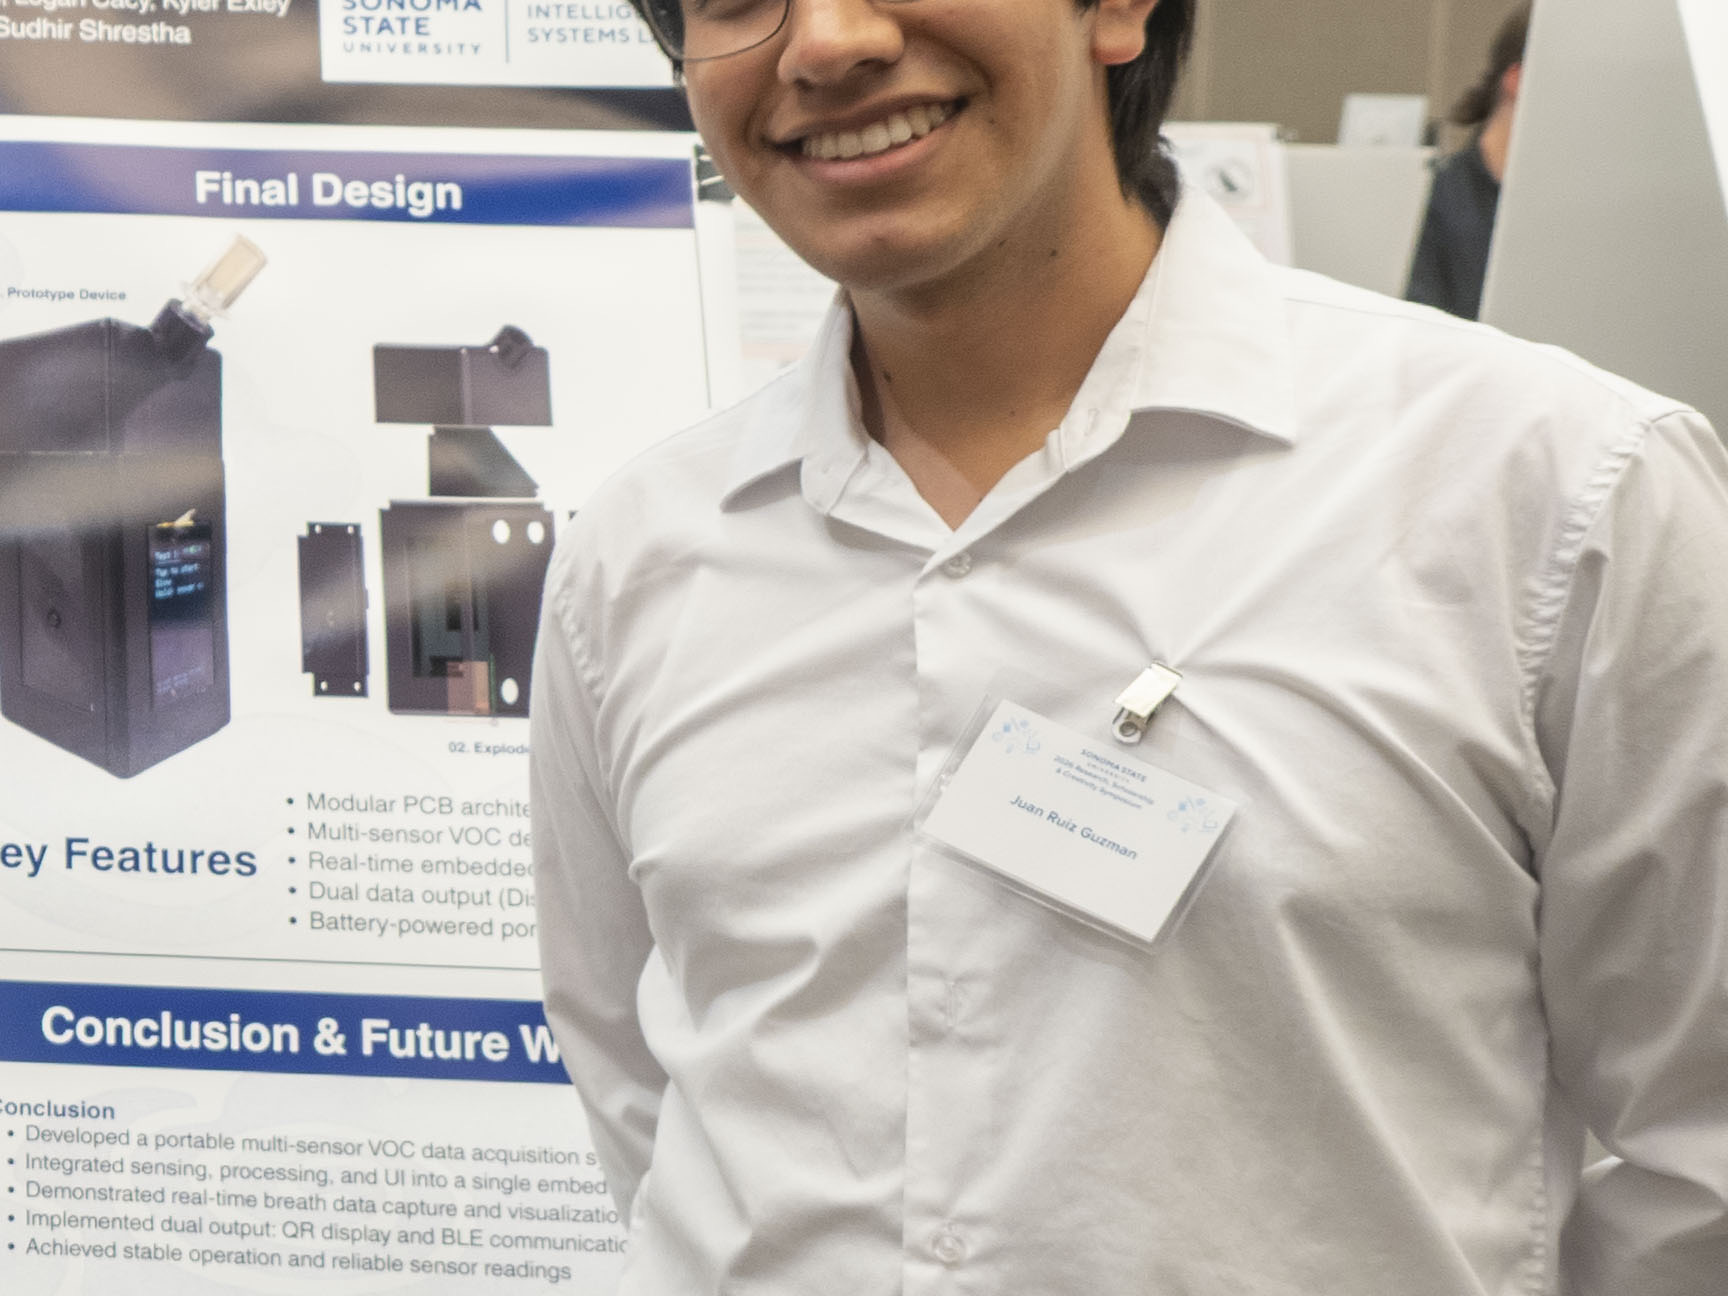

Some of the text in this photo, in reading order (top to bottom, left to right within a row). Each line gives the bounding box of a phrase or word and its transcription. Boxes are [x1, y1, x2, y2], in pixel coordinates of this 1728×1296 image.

[527, 3, 638, 20] INTELLIG
[78, 18, 192, 45] Shrestha
[343, 16, 430, 37] STATE
[527, 27, 631, 44] SYSTEMS
[343, 42, 481, 55] UNIVERSITY
[195, 170, 462, 217] Final Design
[6, 286, 76, 302] Prototype
[79, 288, 127, 301] Device
[306, 791, 454, 816] Modular PCB
[307, 821, 502, 847] Multi-sensor VOC
[1009, 795, 1138, 860] Juan Ruiz Guzman
[65, 837, 257, 877] Features
[308, 850, 414, 874] Real-time
[308, 880, 492, 911] Dual data output
[309, 909, 494, 938] Battery-powered
[41, 1005, 510, 1062] Conclusion & Future
[25, 1236, 572, 1285] Achieved stable operation and reliable sensor readings
